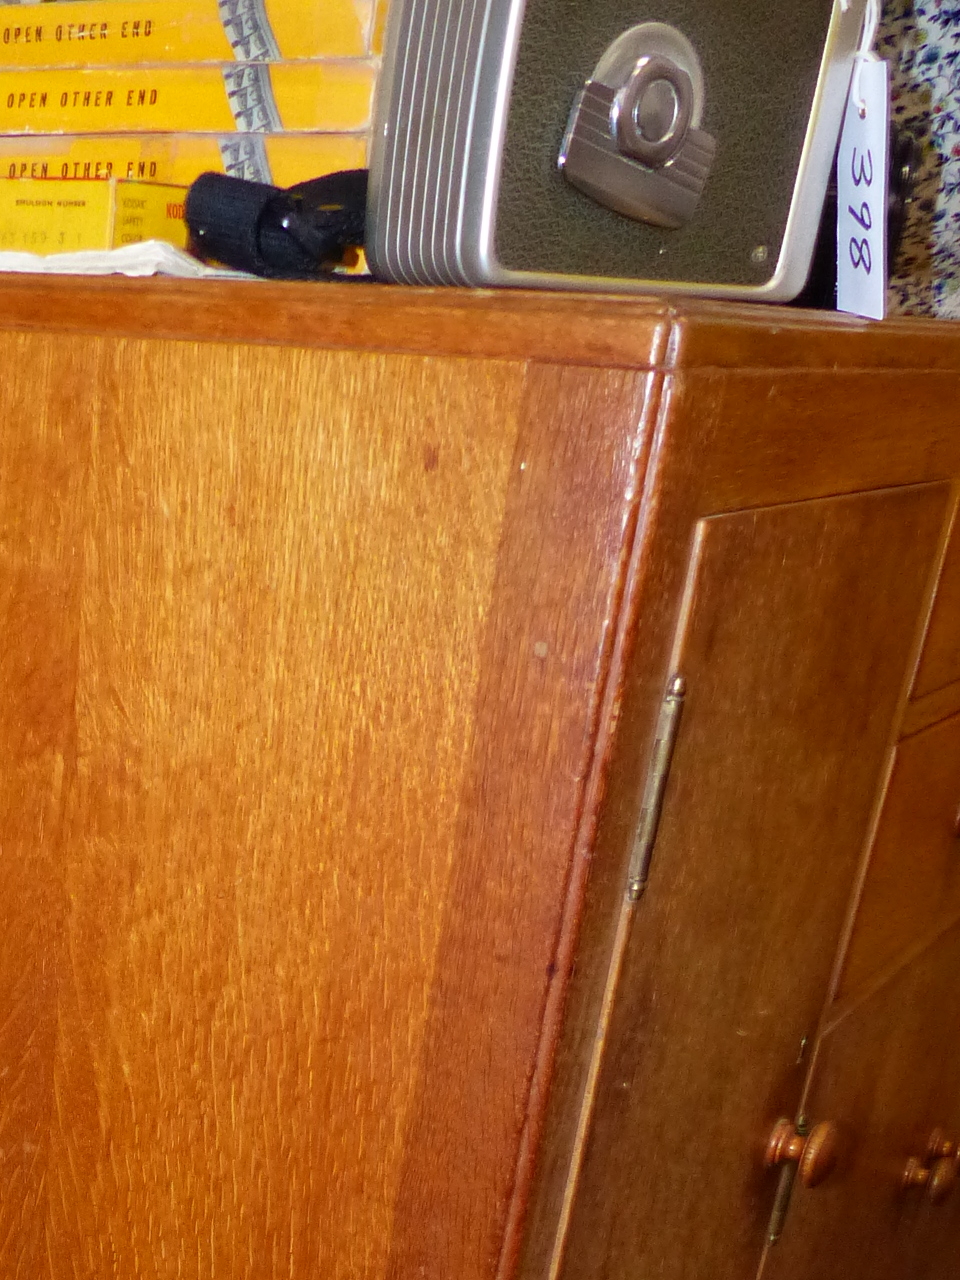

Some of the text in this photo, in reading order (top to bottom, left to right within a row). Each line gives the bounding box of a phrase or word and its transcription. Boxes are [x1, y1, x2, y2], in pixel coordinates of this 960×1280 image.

[3, 20, 152, 44] OPEN OTHER END
[7, 89, 158, 109] OPEN OTHER END
[9, 161, 157, 179] OPEN OTHER END
[847, 147, 873, 275] 398
